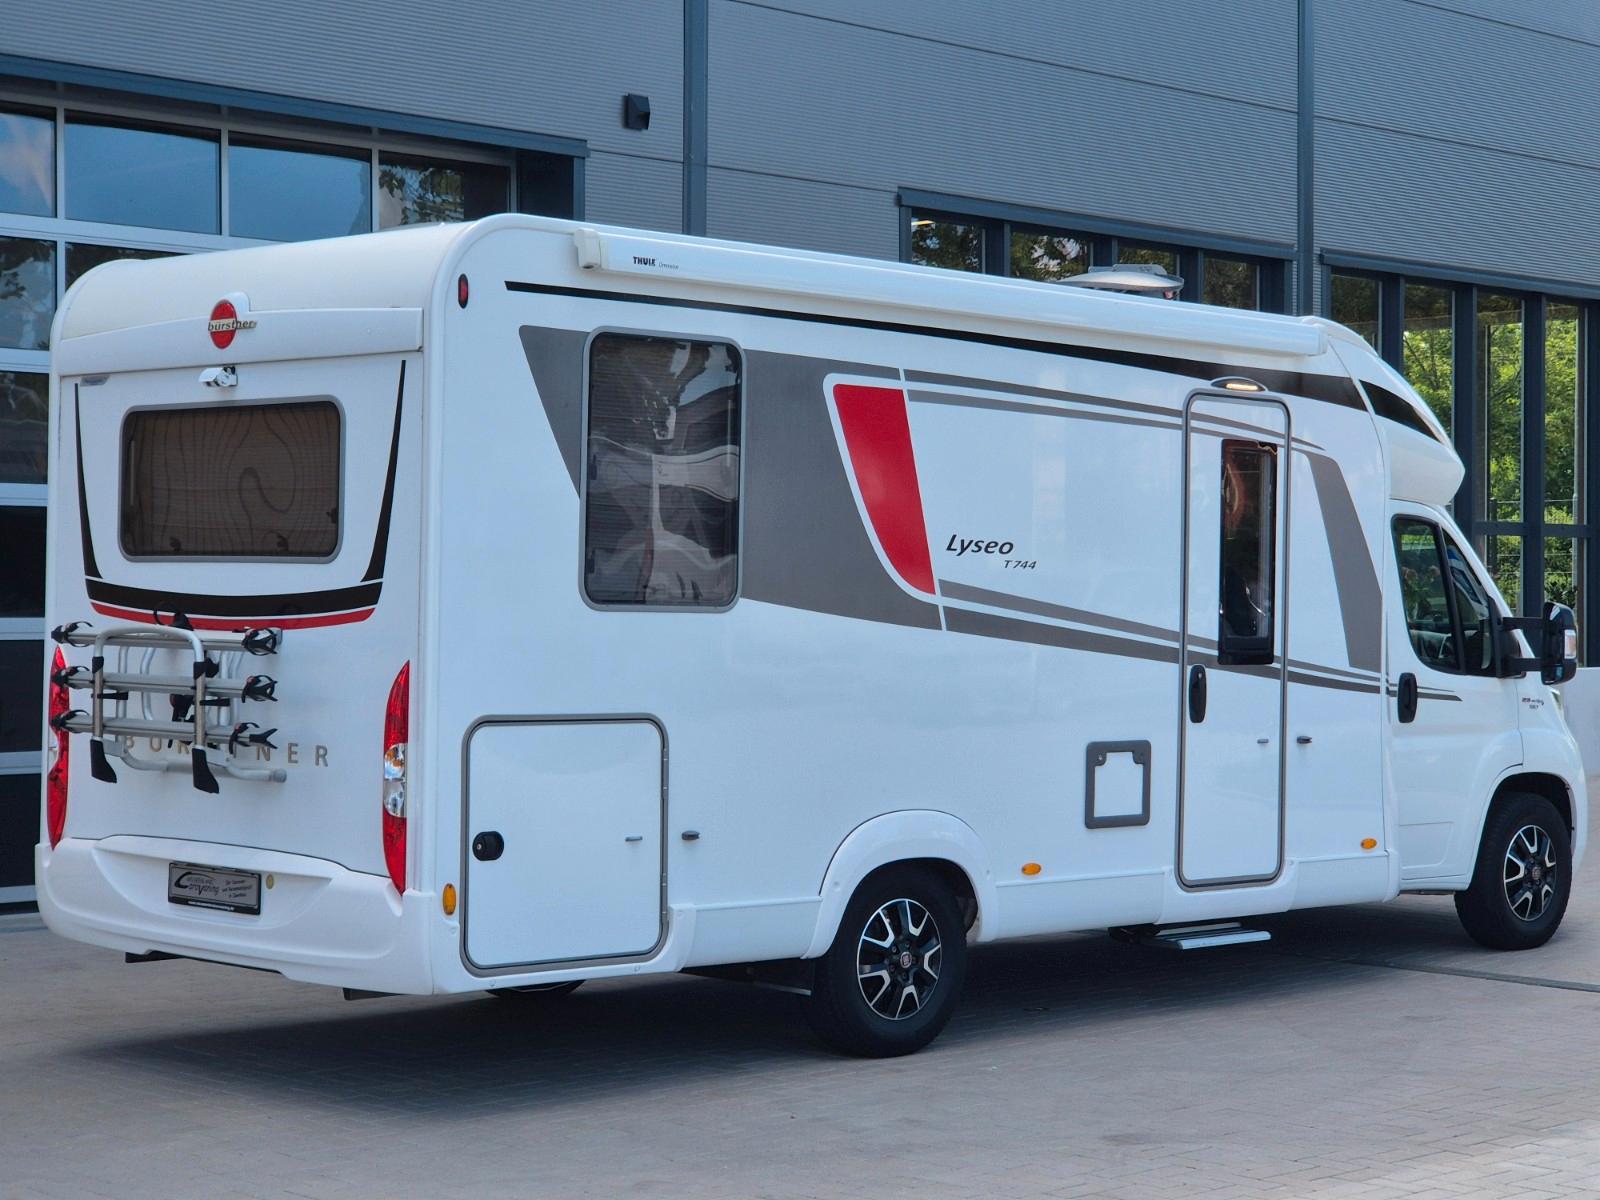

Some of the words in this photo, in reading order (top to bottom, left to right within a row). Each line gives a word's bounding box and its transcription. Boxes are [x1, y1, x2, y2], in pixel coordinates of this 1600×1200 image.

[633, 256, 656, 266] THULE
[946, 534, 1014, 556] Lyseo
[1013, 560, 1037, 569] 744
